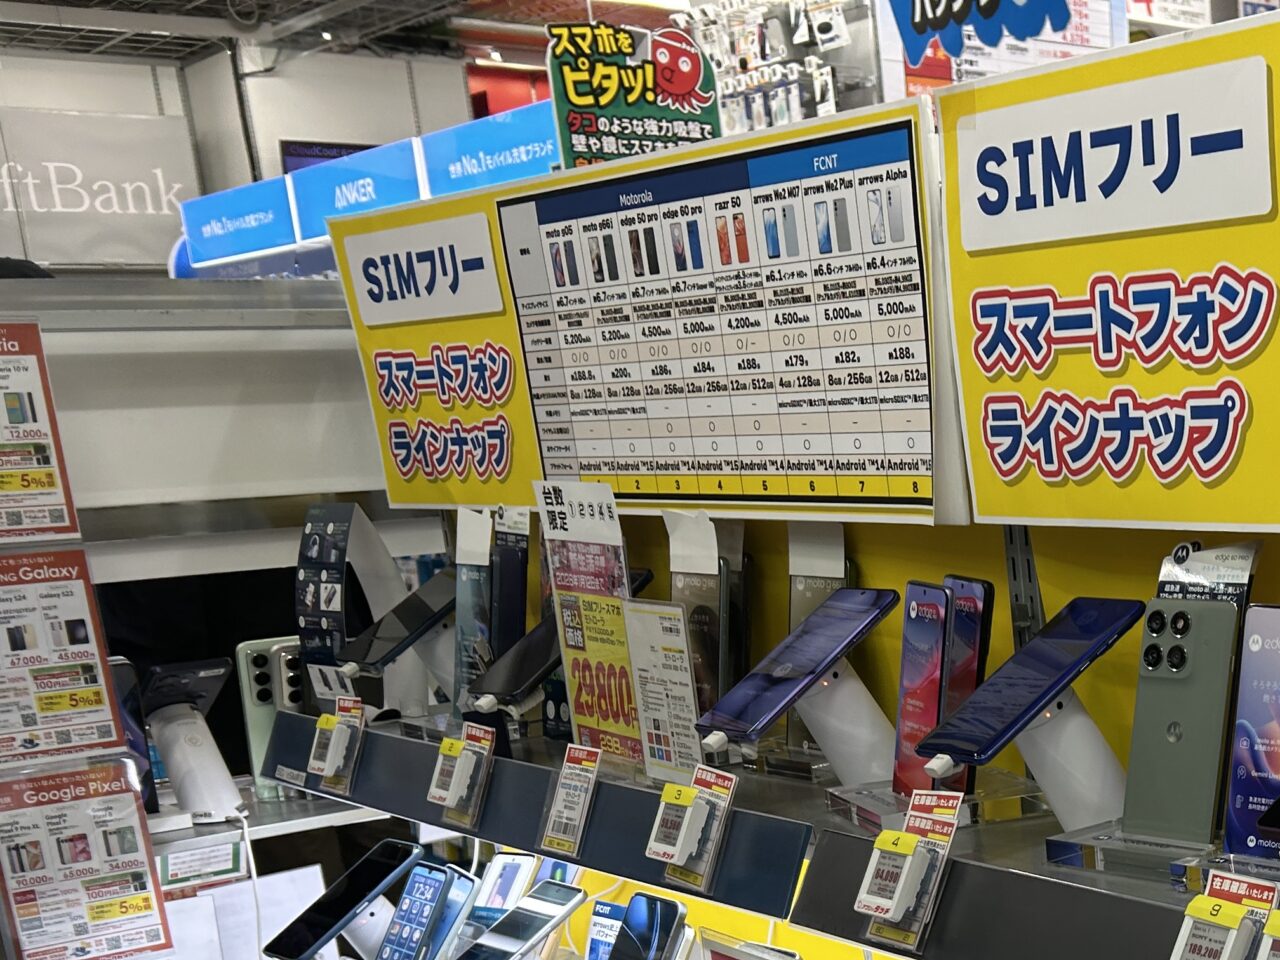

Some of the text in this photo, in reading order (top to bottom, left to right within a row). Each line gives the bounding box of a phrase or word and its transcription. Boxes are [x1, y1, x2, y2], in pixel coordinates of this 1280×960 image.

[550, 24, 634, 56] スマホを
[568, 112, 713, 139] タコのような強力吸盤で
[813, 154, 838, 171] FCNT
[976, 113, 1244, 216] SIMフリー
[858, 169, 908, 187] arrows Alpha
[335, 177, 376, 209] ANKER
[619, 190, 653, 207] Motorola
[714, 196, 741, 211] razr 50
[662, 206, 679, 220] edge
[363, 244, 485, 303] SIMフリー
[973, 268, 1269, 368] スマートフォン
[377, 345, 510, 403] スマートフォン
[985, 388, 1241, 474] ラインナップ
[391, 420, 508, 476] ラインナップ
[542, 485, 565, 506] 台数
[634, 480, 641, 490] 2
[912, 481, 919, 493] 8
[547, 510, 569, 532] 限定
[19, 565, 78, 580] Galaxy
[68, 693, 94, 708] 5%
[23, 778, 126, 804] Google Pixel
[891, 837, 900, 848] 4
[1212, 876, 1274, 901] 在庫確認いたします
[119, 901, 142, 914] 5%
[1209, 904, 1222, 917] 9
